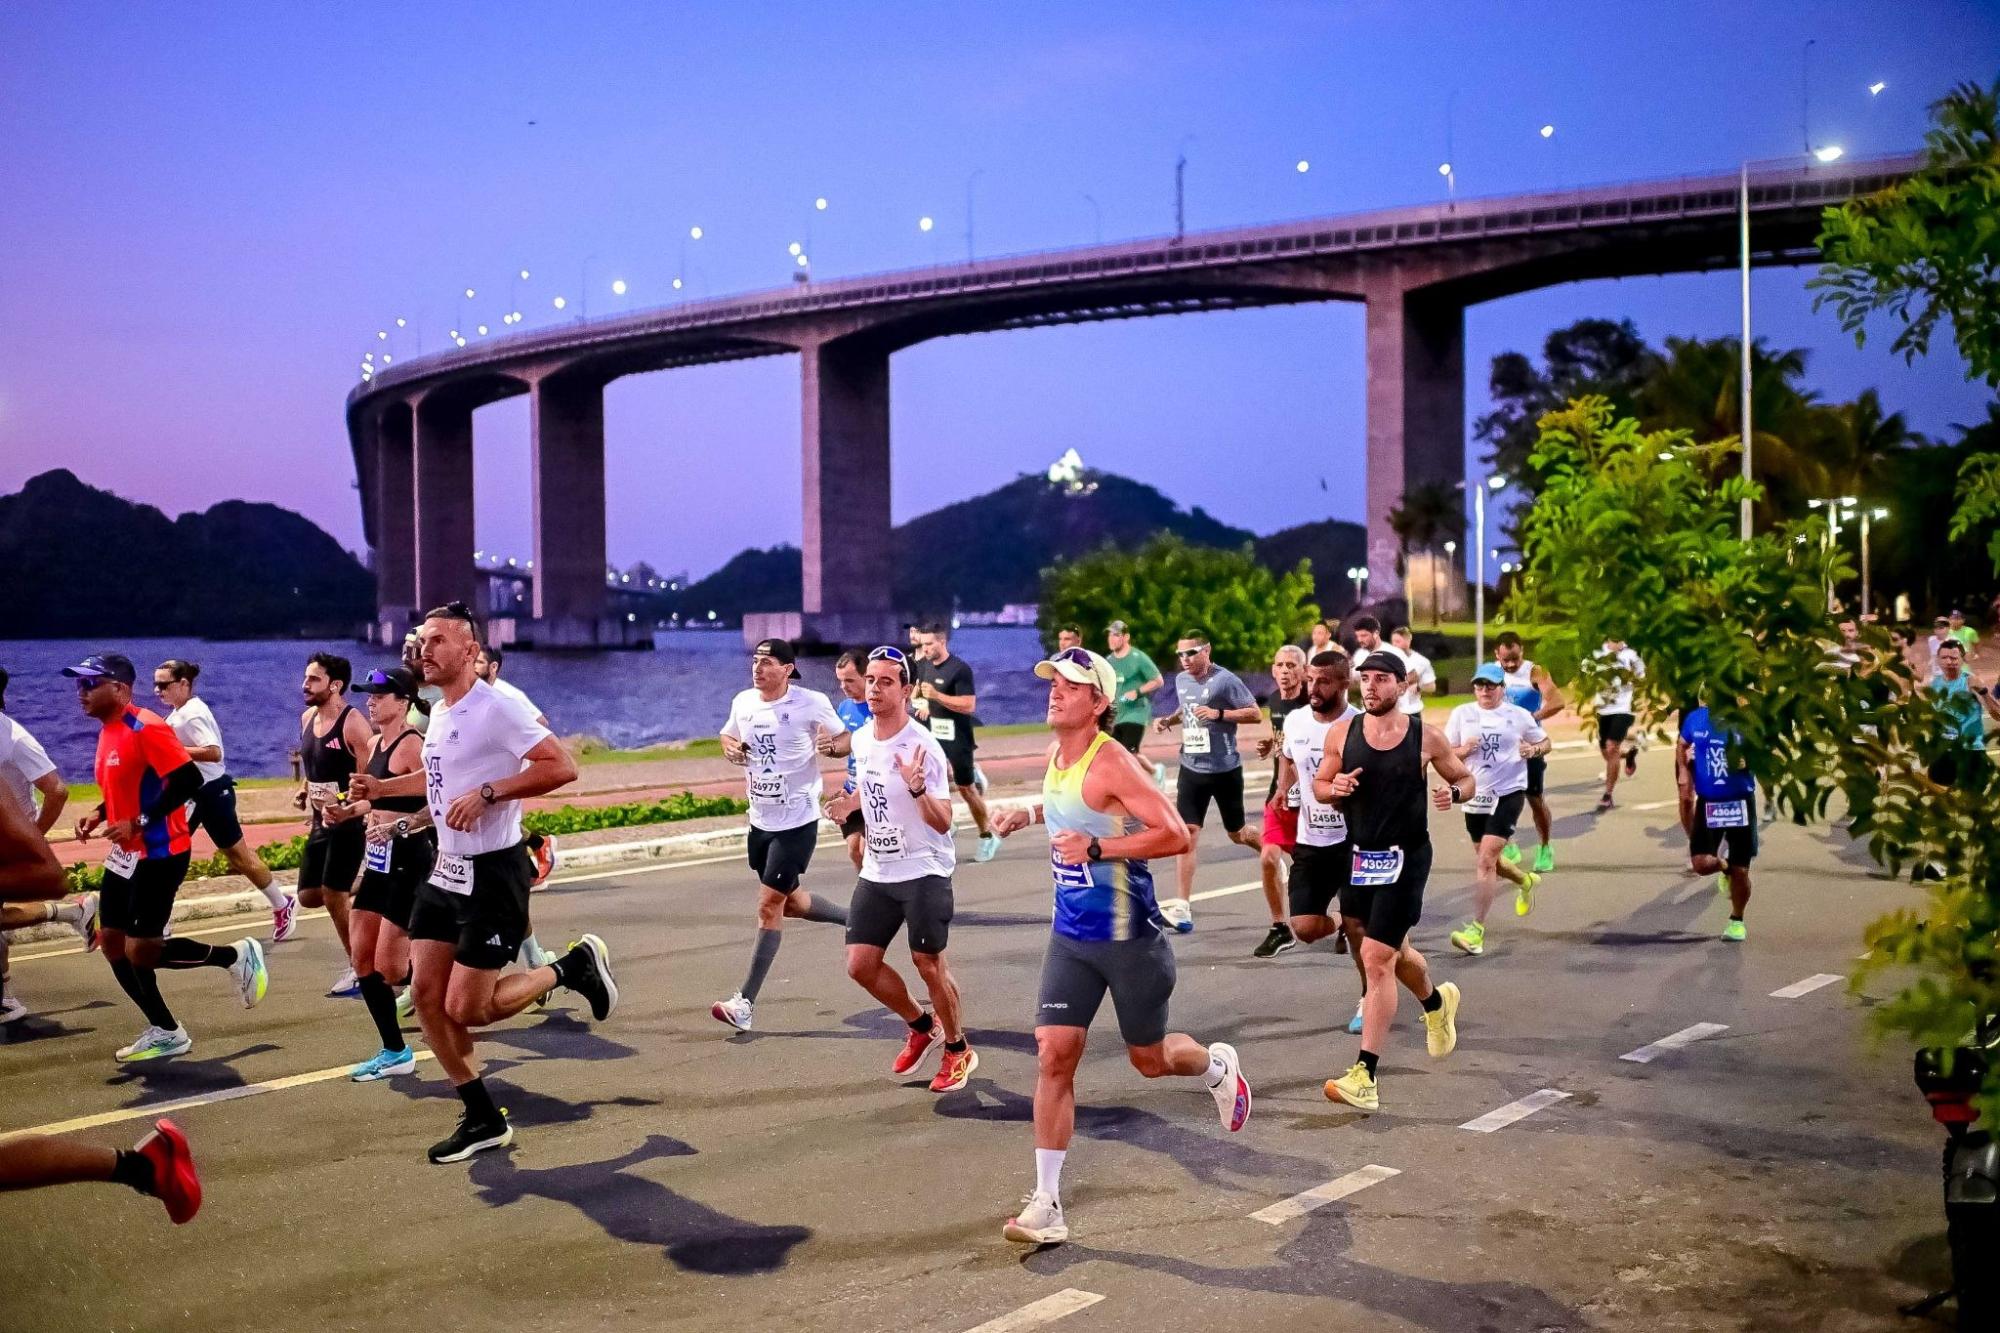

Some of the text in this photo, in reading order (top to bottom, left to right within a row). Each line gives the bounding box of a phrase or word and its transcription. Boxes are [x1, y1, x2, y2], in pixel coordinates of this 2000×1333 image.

[752, 780, 782, 791] 26979
[1312, 813, 1342, 823] 24581
[869, 834, 899, 847] 24905
[1360, 858, 1397, 870] 43027
